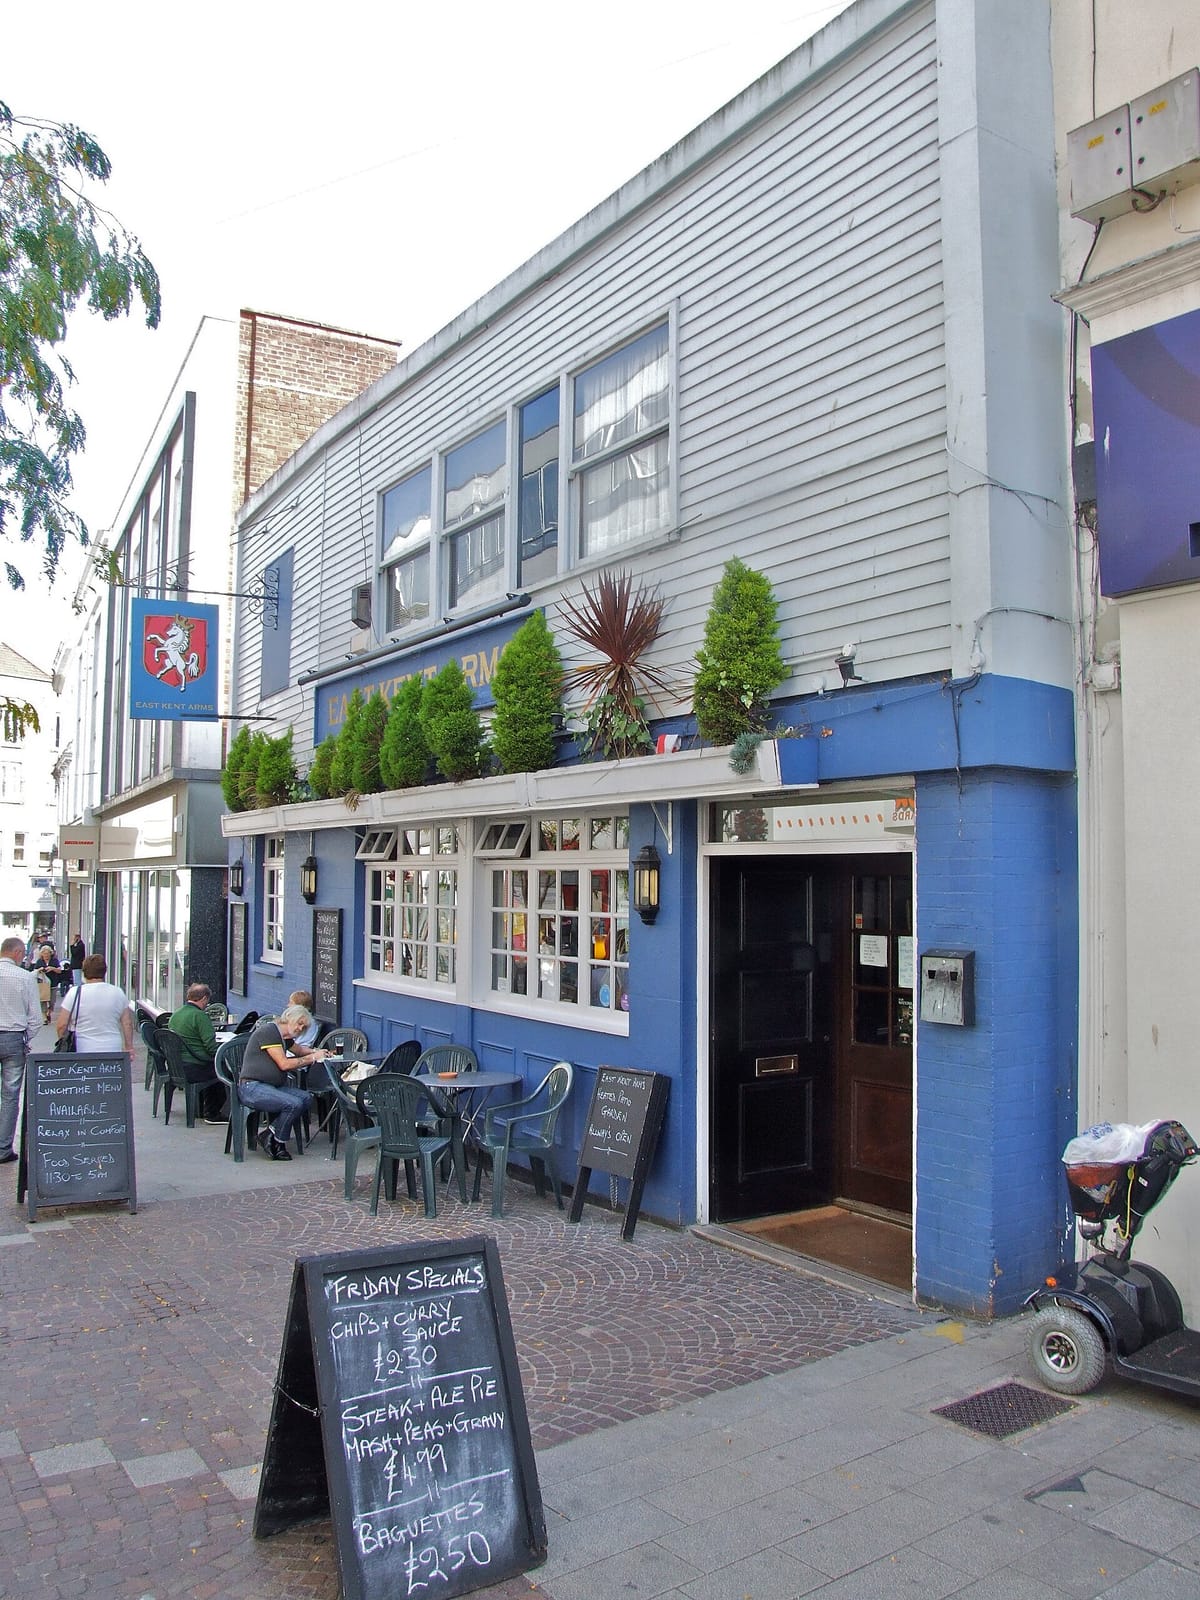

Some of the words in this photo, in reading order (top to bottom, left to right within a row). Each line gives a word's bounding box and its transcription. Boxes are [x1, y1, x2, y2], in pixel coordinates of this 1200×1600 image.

[136, 701, 160, 709] EAST
[328, 685, 374, 726] EAT
[38, 1064, 65, 1078] EAST
[67, 1063, 96, 1074] KENT
[601, 1073, 617, 1083] EAST
[617, 1075, 632, 1086] KENT
[38, 1083, 91, 1095] LUNCHTIME
[97, 1082, 122, 1094] MENU
[50, 1102, 108, 1116] AVAILABLE
[601, 1105, 628, 1122] GARDEN
[37, 1125, 70, 1139] RELAX
[90, 1124, 126, 1135] COMFORT
[615, 1129, 633, 1144] OPEN
[42, 1152, 70, 1168] FOOD
[73, 1153, 115, 1167] SERVED
[333, 1273, 401, 1304] FRIDAY
[406, 1265, 485, 1290] SPECIALS
[331, 1312, 380, 1339] CHIPS
[393, 1298, 453, 1326] CURRY
[402, 1316, 463, 1343] SAUCE
[431, 1385, 465, 1409] ALE
[470, 1374, 498, 1403] PIE
[383, 1443, 448, 1502] £4.99
[359, 1489, 484, 1554] BAGUETTES
[403, 1531, 491, 1595] £2.50
